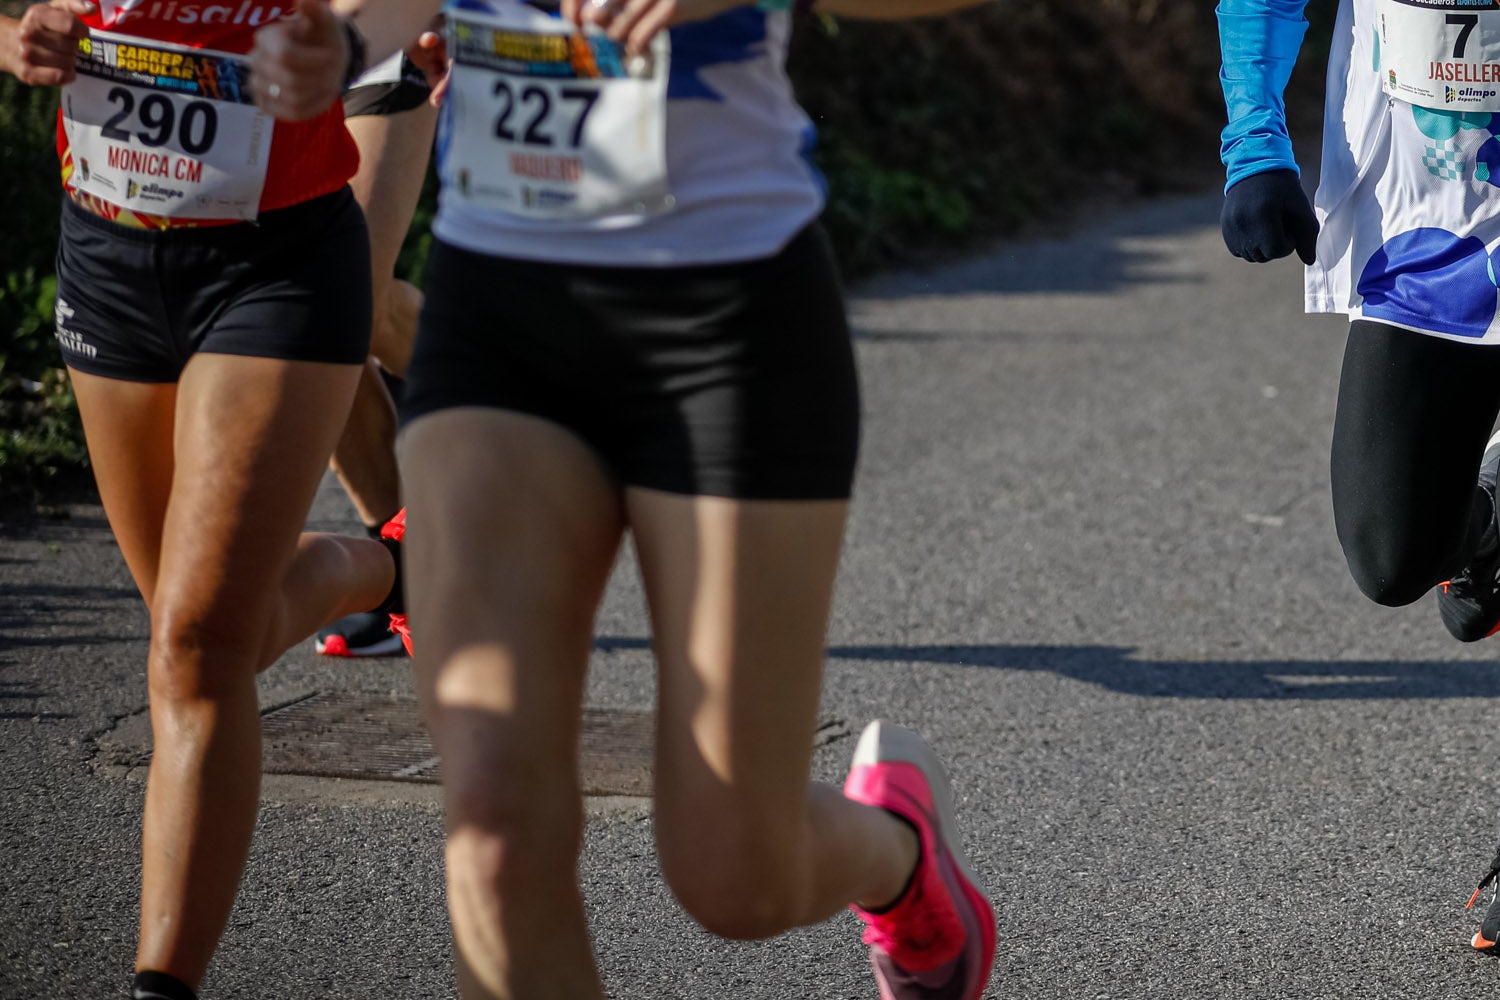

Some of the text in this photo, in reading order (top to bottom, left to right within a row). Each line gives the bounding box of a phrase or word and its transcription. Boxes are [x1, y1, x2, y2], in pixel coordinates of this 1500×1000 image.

[1445, 14, 1479, 59] 7
[117, 44, 195, 69] CARRERA
[117, 57, 195, 80] POPULAR
[493, 78, 599, 147] 227
[1458, 87, 1497, 99] olimpo
[101, 87, 218, 155] 290
[108, 145, 203, 184] MONICA CM
